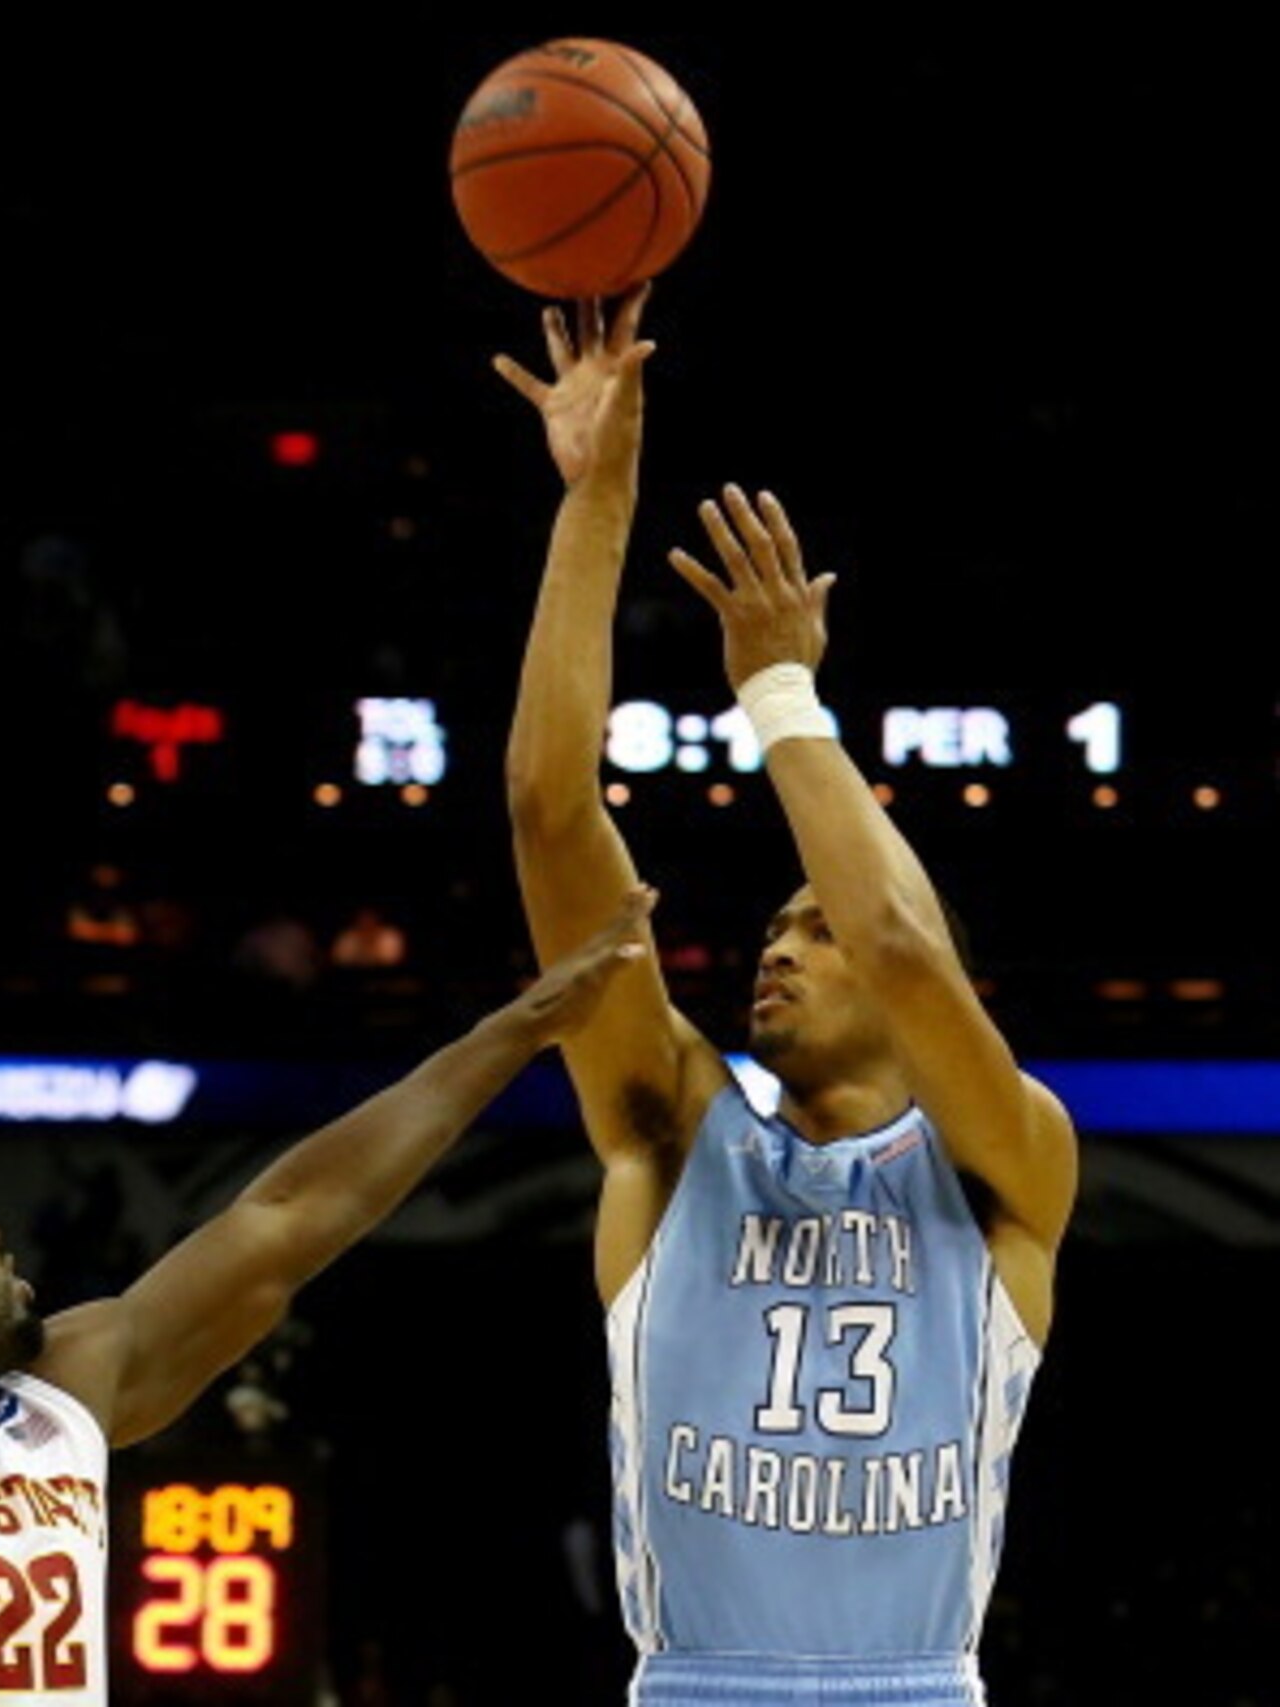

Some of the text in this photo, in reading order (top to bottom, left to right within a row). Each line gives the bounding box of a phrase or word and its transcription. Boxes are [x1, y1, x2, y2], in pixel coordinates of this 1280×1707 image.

[882, 702, 1120, 773] PER 1
[729, 1208, 915, 1294] NORTH
[755, 1302, 898, 1438] 13
[141, 1484, 294, 1552] 18:09
[665, 1422, 968, 1538] CAROLINA
[132, 1554, 277, 1673] 28
